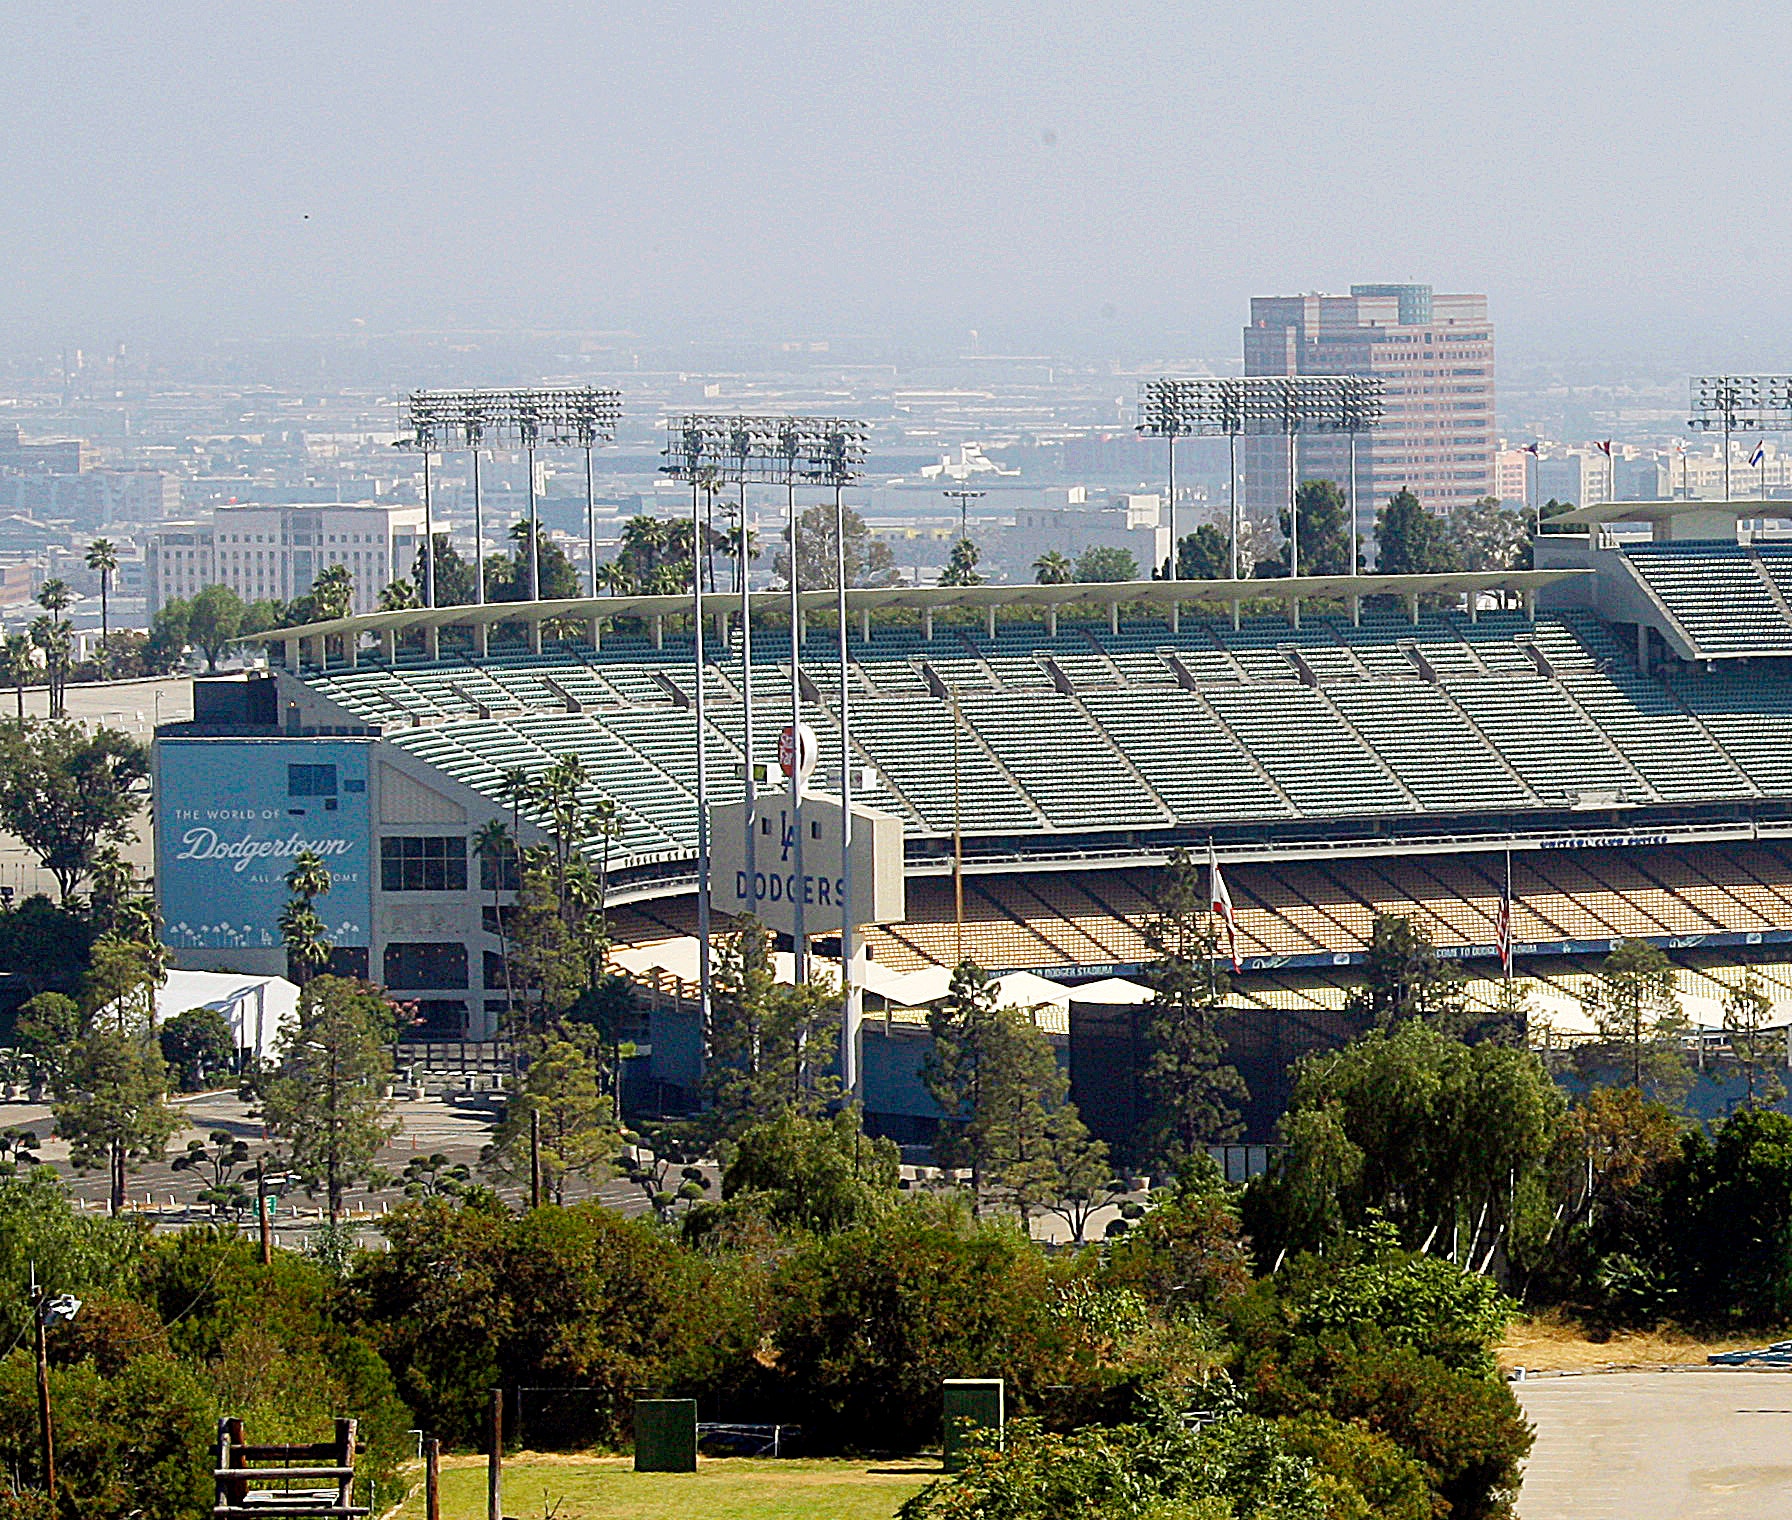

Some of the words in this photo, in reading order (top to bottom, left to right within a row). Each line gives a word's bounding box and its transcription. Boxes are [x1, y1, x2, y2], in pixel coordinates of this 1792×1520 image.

[176, 809, 200, 820] THE
[207, 809, 255, 820] WORLD
[262, 809, 280, 819] OF
[176, 827, 354, 873] Dodgertown
